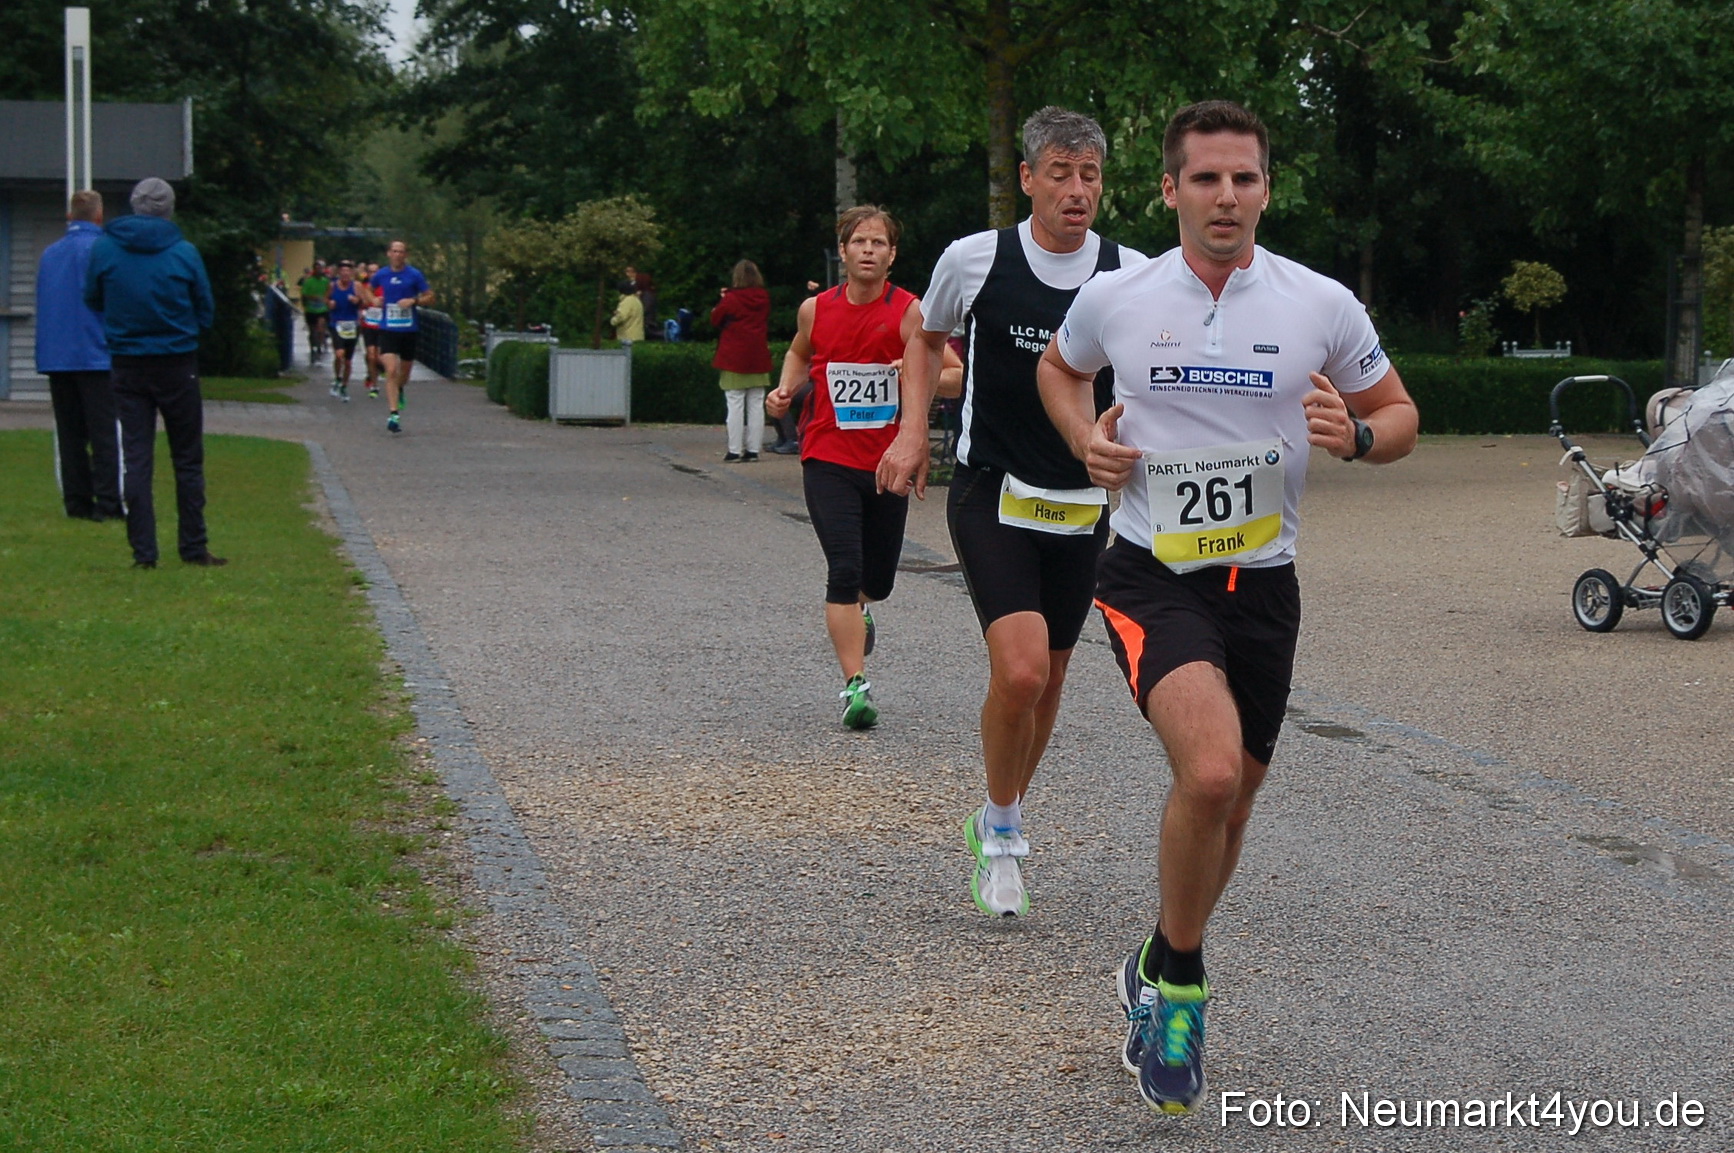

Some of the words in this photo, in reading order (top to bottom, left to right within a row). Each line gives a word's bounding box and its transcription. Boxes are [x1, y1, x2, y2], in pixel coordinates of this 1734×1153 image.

[1010, 325, 1035, 338] LLC
[1038, 328, 1055, 341] Ma
[1015, 338, 1046, 353] Rege
[1189, 369, 1269, 386] BÜSCHEL
[834, 378, 888, 403] 2241
[850, 409, 875, 420] Peter
[1147, 463, 1192, 476] PARTL
[1195, 455, 1260, 473] Neumarkt
[1176, 474, 1254, 525] 261
[1035, 503, 1066, 522] Hans
[1197, 532, 1246, 555] Frank
